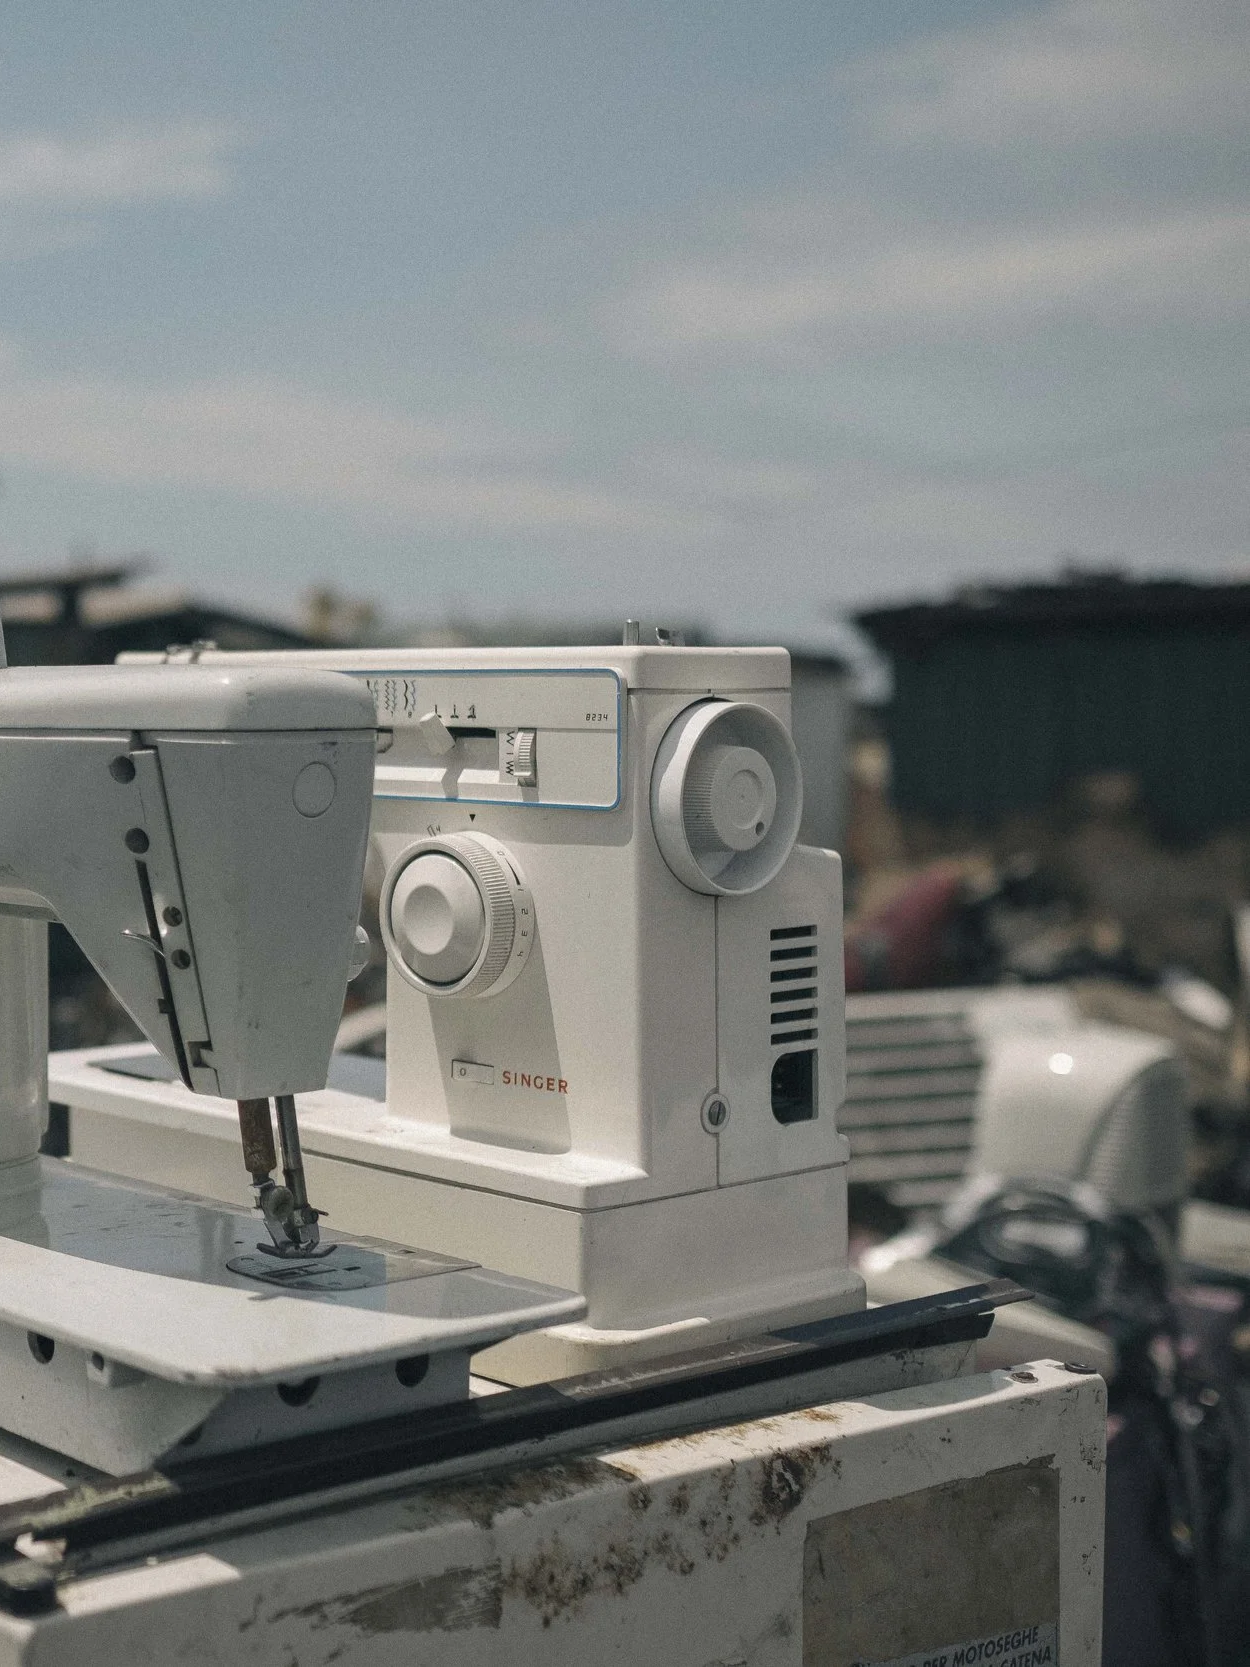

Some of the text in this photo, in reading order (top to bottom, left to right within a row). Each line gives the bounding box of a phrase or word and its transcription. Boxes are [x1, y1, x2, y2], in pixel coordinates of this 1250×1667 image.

[585, 713, 608, 722] 8234
[502, 1070, 568, 1094] SINGER
[952, 1625, 1039, 1667] MOTOSEGHE
